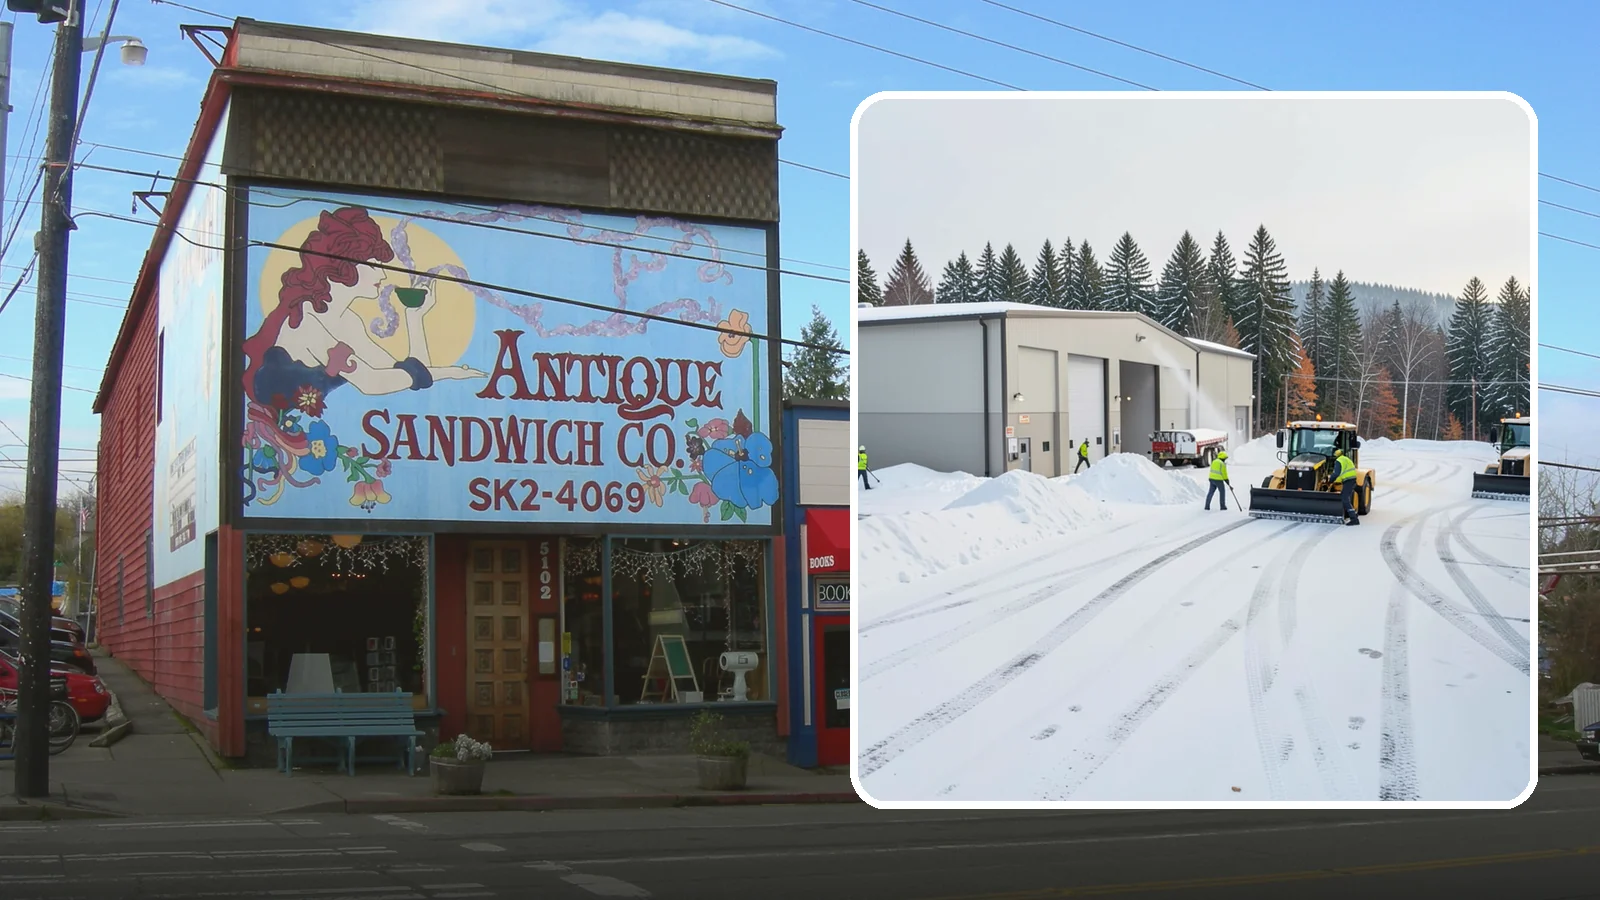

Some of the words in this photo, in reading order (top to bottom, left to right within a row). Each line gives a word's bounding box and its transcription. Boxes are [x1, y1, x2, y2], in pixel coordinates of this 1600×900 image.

[475, 329, 724, 421] ANTIQUE
[361, 408, 604, 467] SANDWICH
[617, 422, 685, 469] CO.
[468, 477, 646, 513] SK2-4069
[540, 542, 551, 599] 5102
[809, 555, 835, 569] BOOKS
